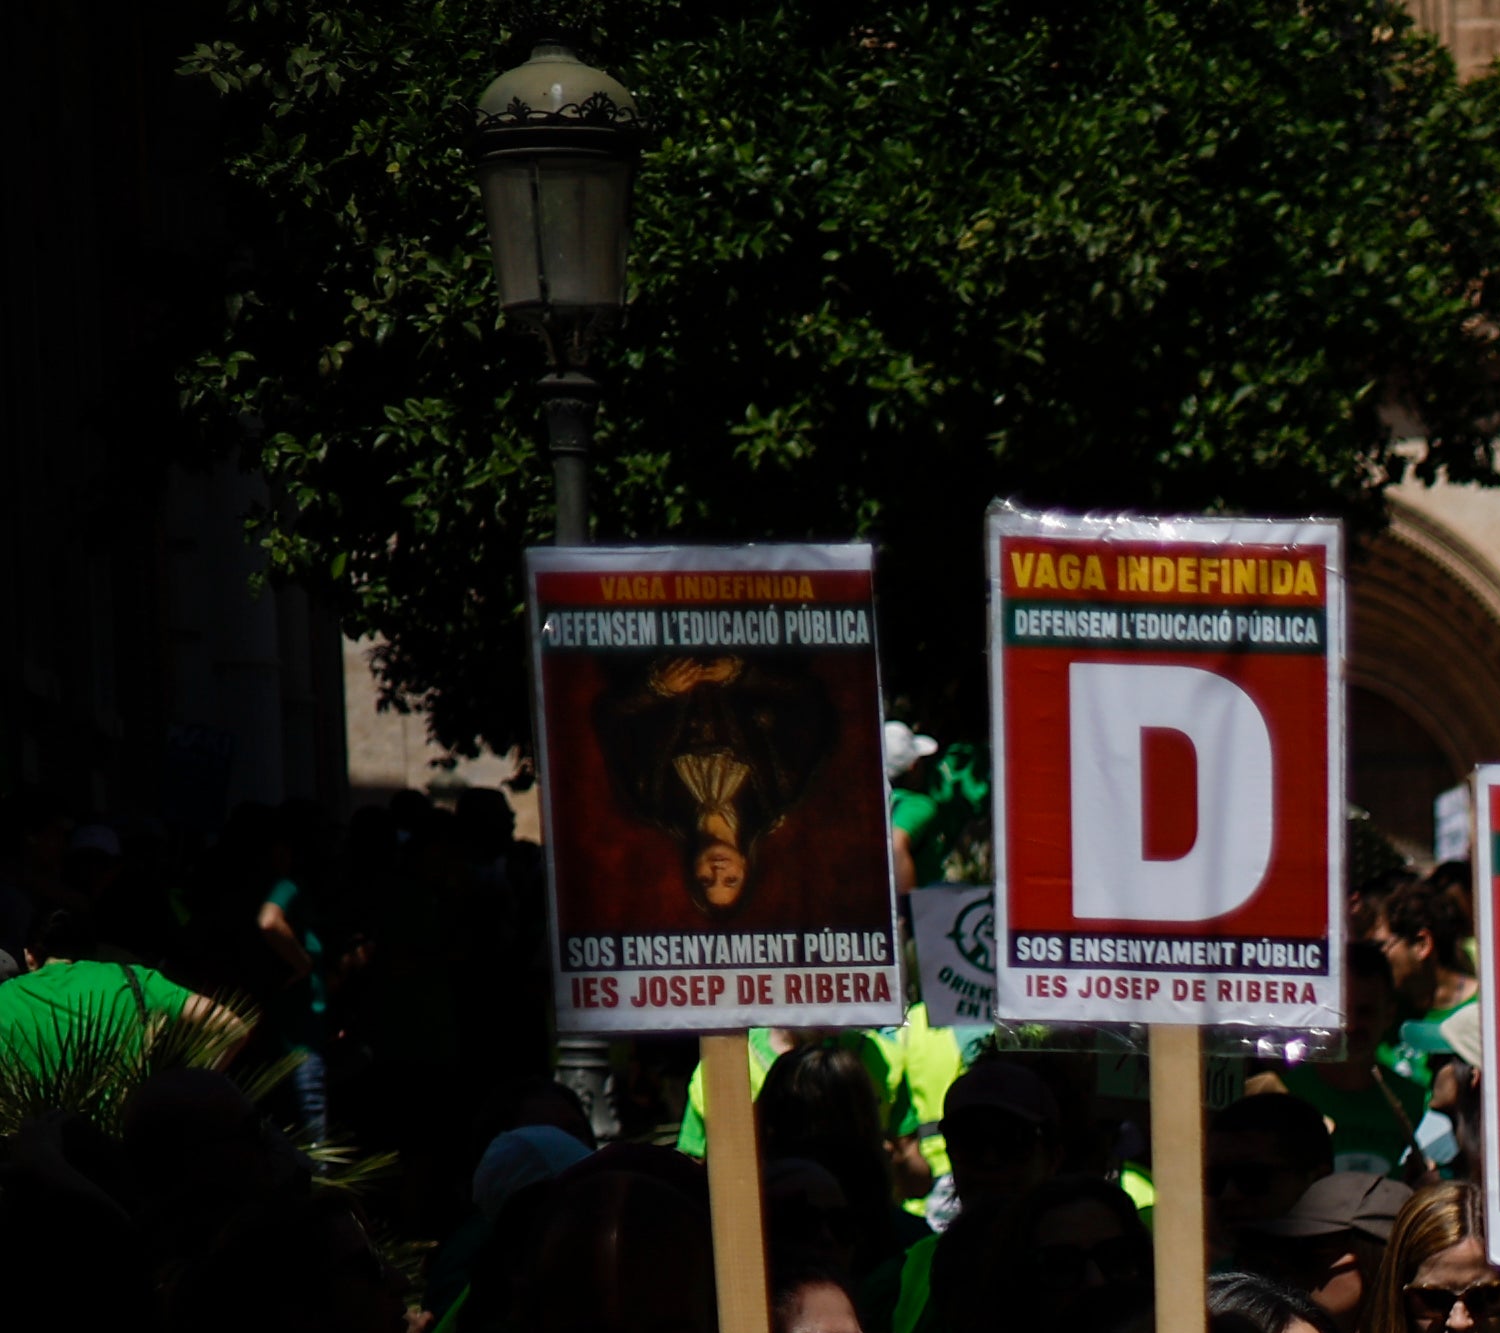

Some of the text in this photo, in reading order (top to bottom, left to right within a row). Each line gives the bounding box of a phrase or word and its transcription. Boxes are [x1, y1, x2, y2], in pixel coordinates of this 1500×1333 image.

[600, 575, 815, 600] VAGA INDEFINIDA
[1010, 552, 1317, 595] VAGA INDEFINIDA
[549, 603, 870, 647] DEFENSEM L'EDUCACIÓ PÚBLICA
[1015, 609, 1317, 643] DEFENSEM L'EDUCACIÓ PÚBLICA
[1068, 661, 1272, 921] D
[568, 928, 886, 966] SOS ENSENYAMENT PÚBLIC
[1016, 936, 1320, 968] SOS ENSENYAMENT PÚBLIC
[571, 972, 891, 1008] IES JOSEP DE RIBERA
[1026, 975, 1316, 1004] IES JOSEP DE RIBERA
